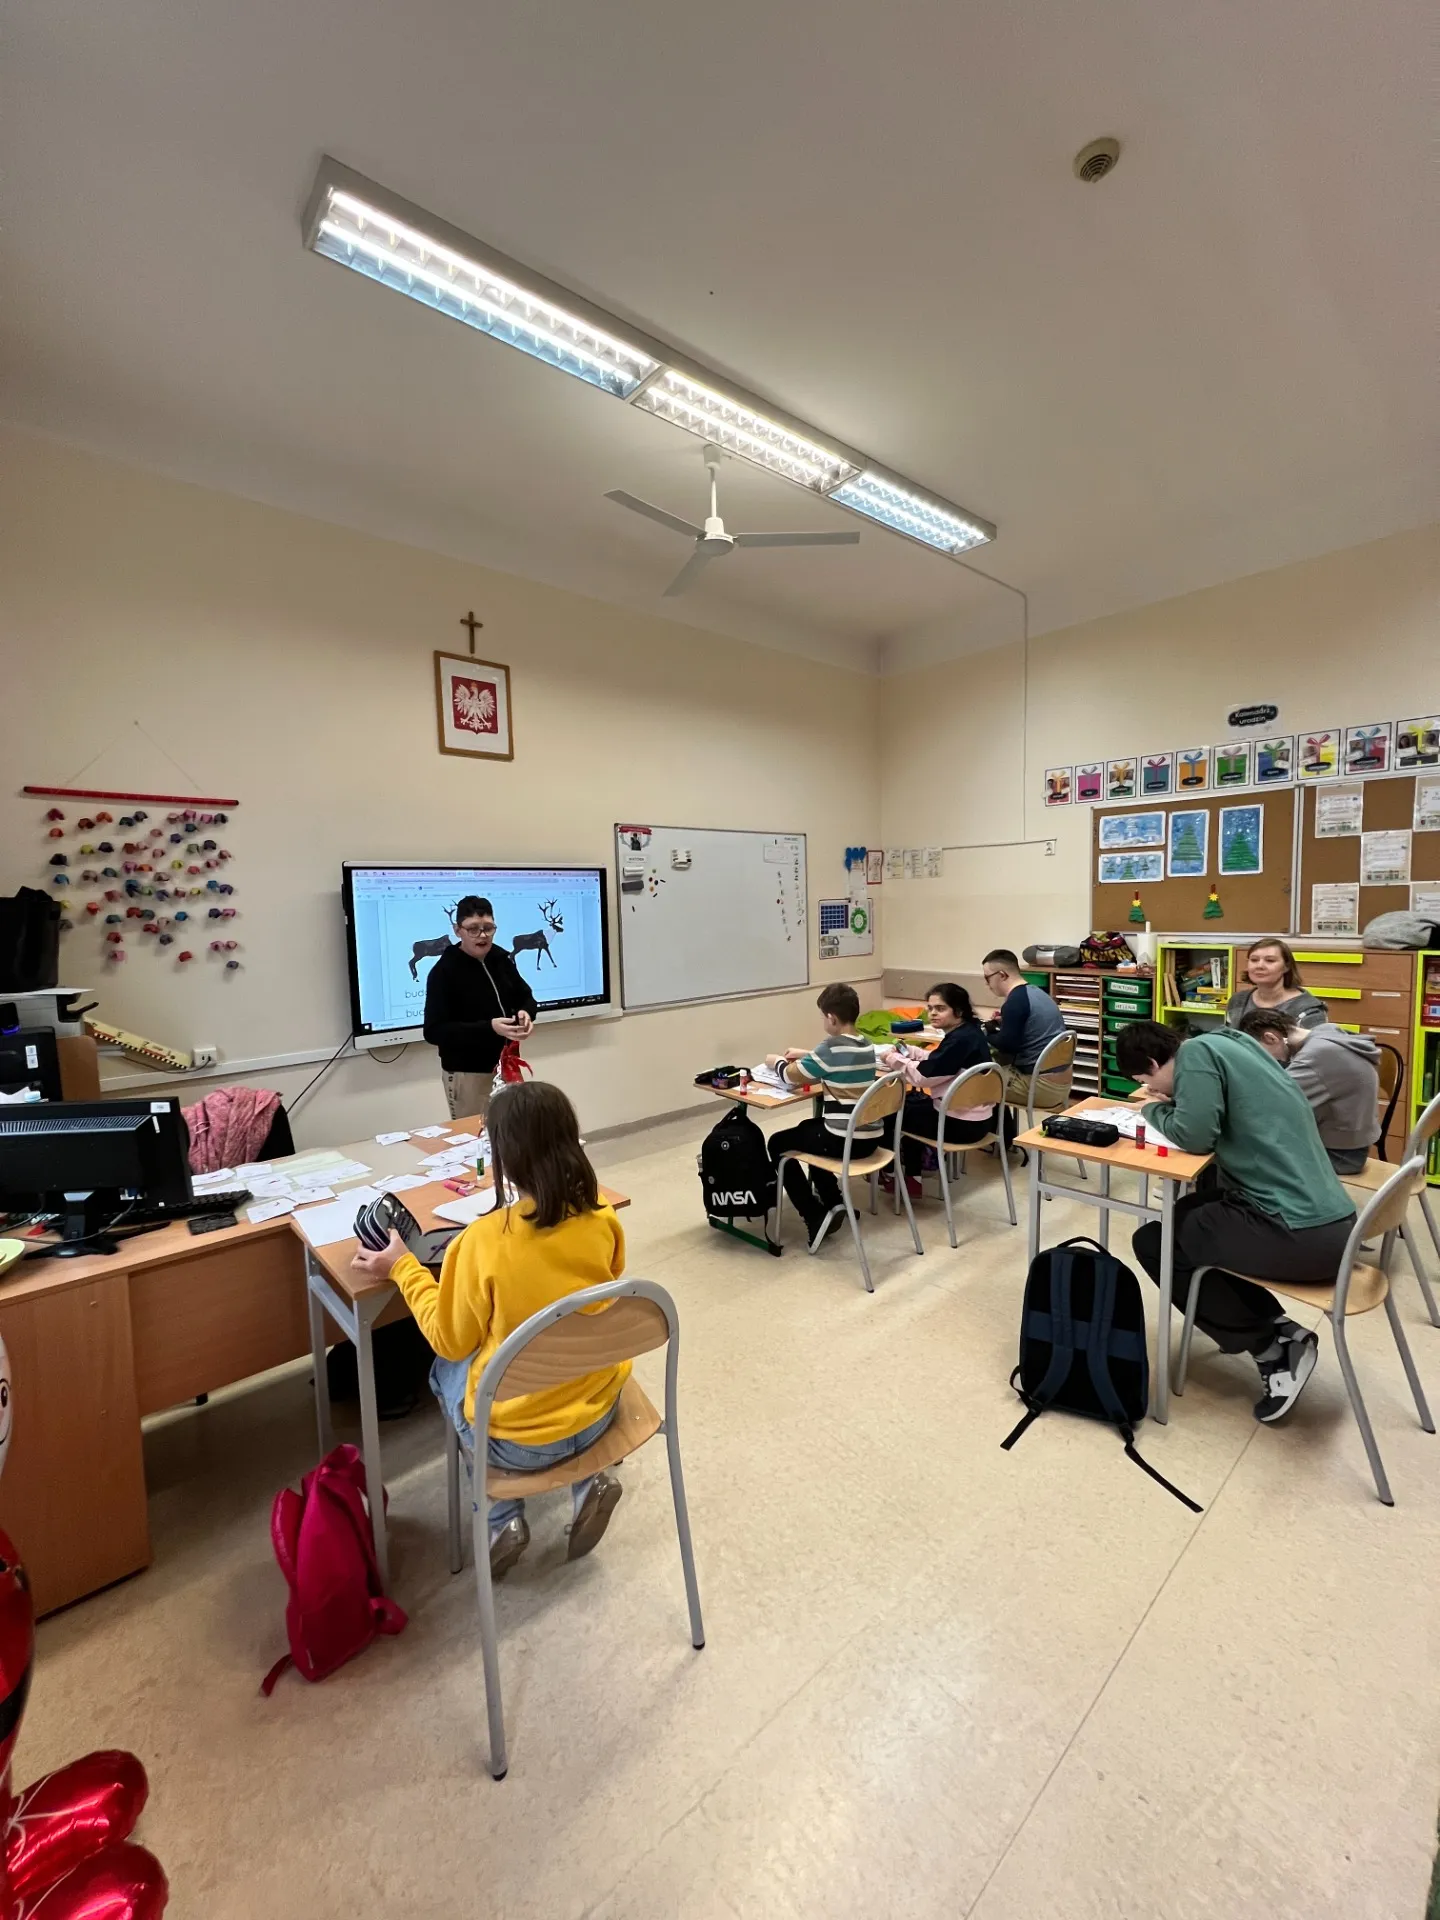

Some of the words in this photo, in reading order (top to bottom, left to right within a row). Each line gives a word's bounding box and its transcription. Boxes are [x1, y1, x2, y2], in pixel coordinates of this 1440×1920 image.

[1239, 716, 1266, 725] urodzin
[405, 989, 427, 998] bud
[711, 1190, 757, 1206] NASA
